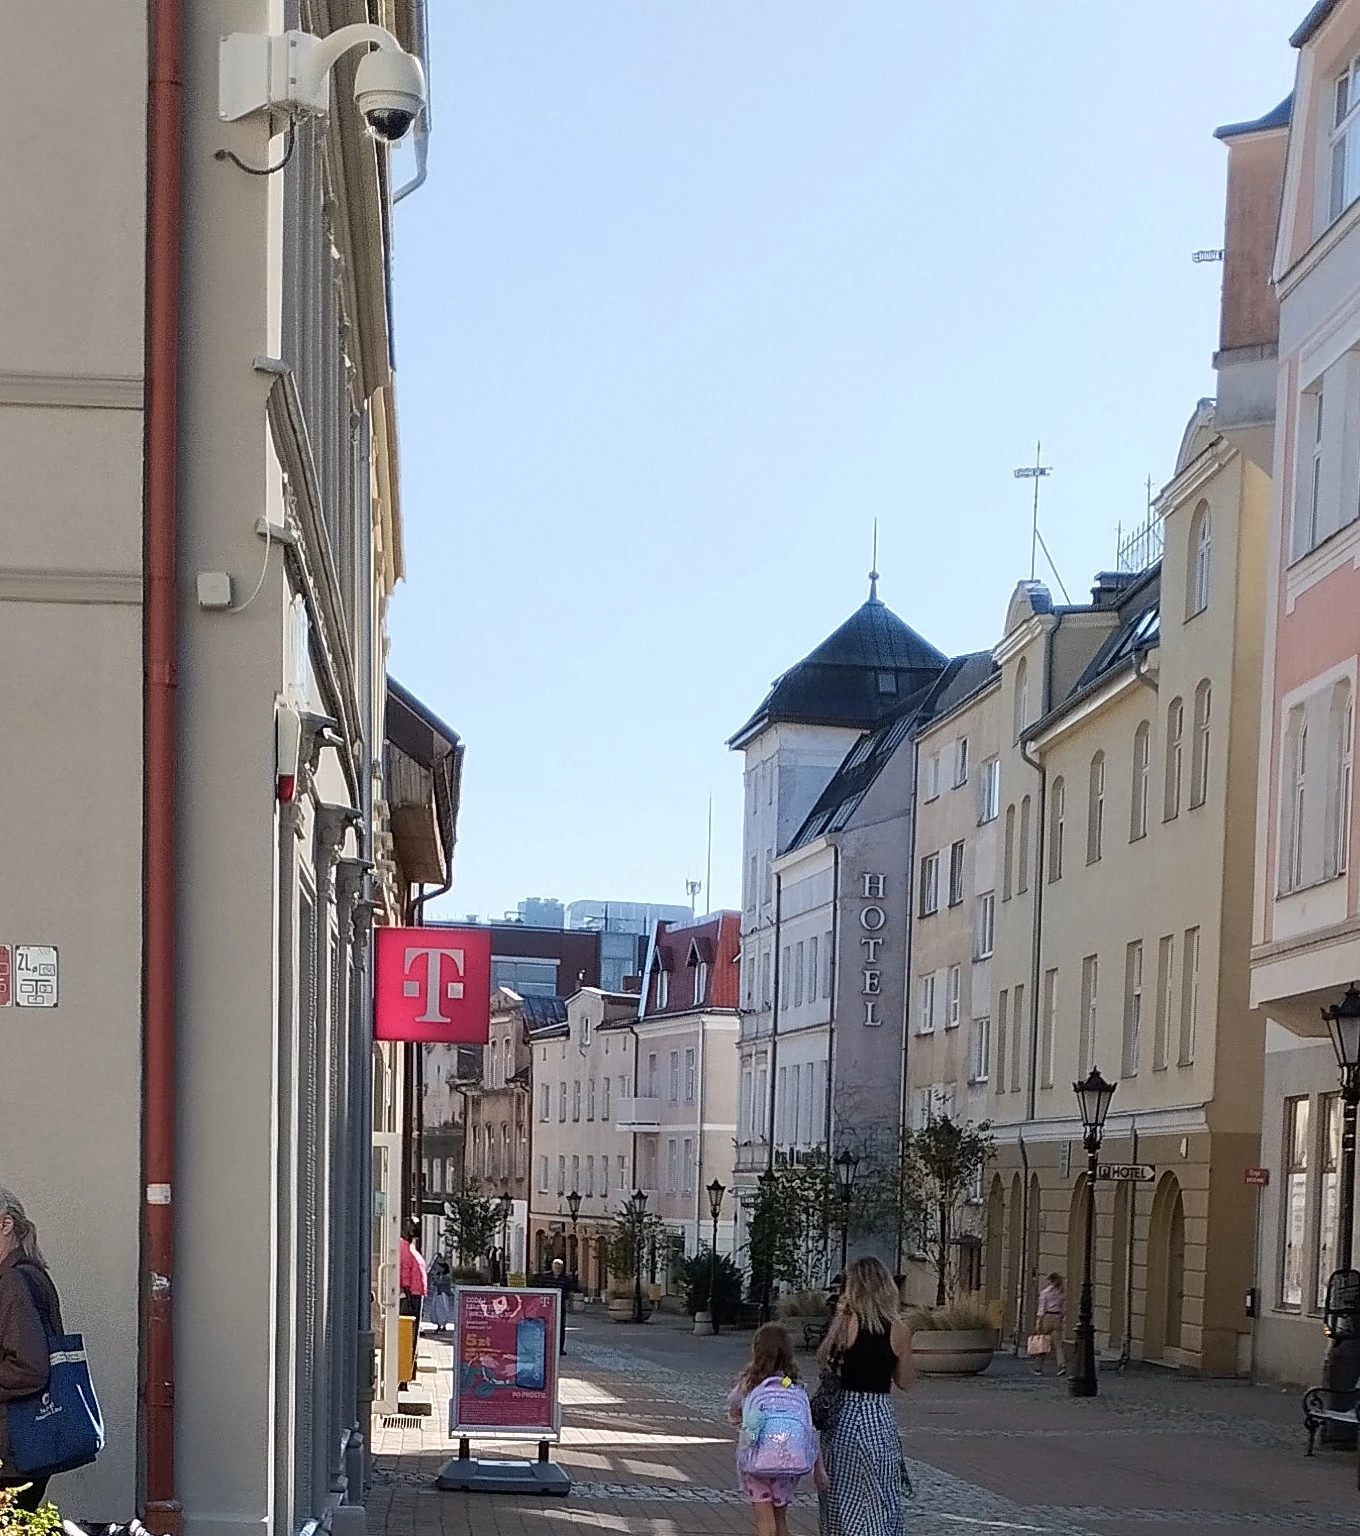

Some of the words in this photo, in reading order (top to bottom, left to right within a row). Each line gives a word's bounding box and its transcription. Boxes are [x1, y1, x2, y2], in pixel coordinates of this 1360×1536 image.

[403, 946, 465, 1024] T
[860, 871, 887, 1028] HOTEL
[1111, 1165, 1147, 1179] HOTEL
